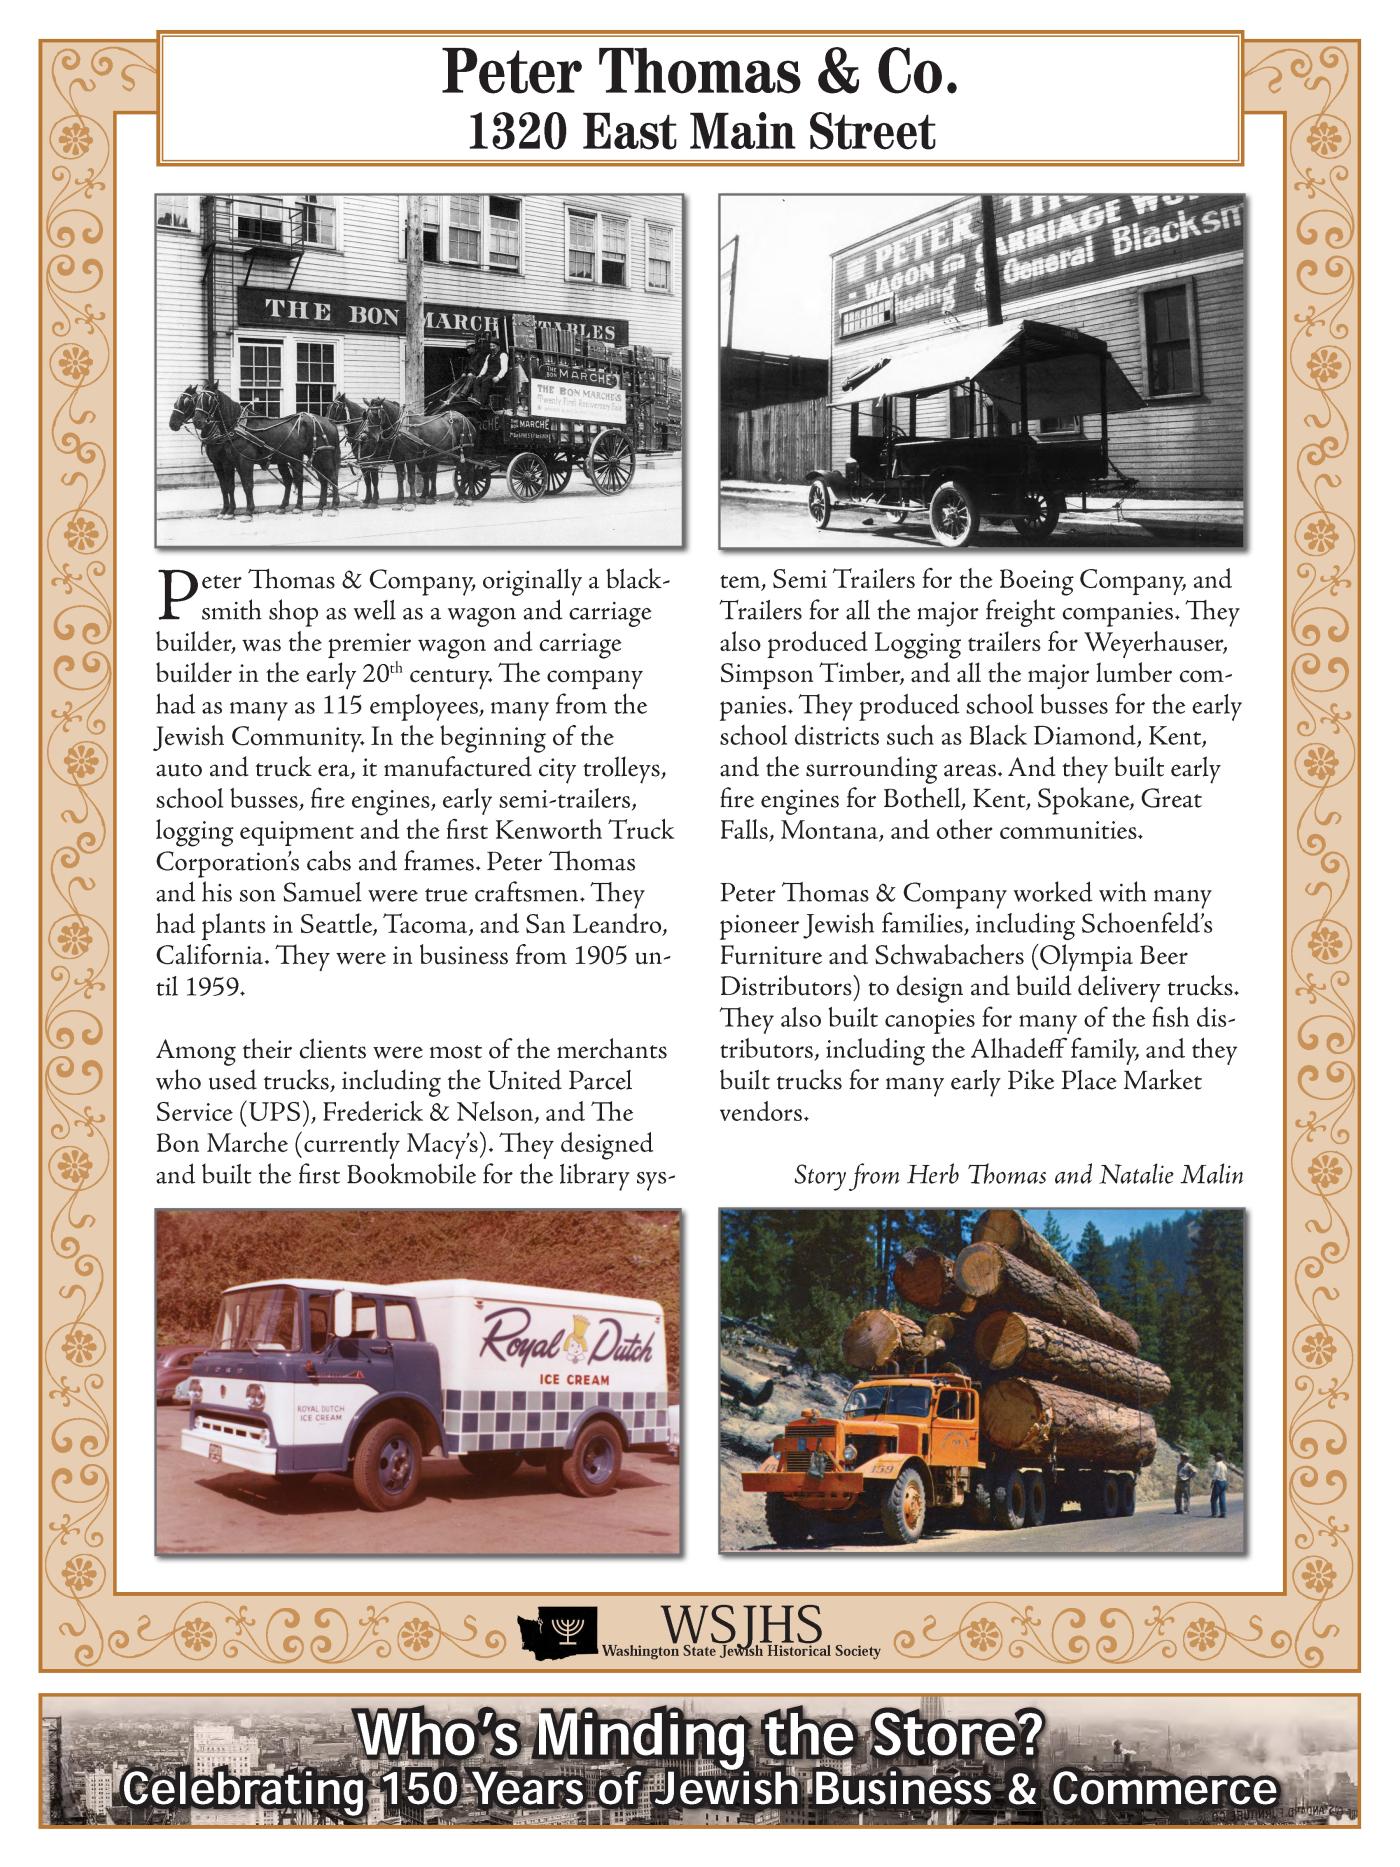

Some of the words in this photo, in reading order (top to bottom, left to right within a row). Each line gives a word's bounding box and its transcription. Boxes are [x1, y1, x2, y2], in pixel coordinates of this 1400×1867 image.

[443, 48, 582, 93] Peter
[599, 48, 800, 93] Thomas
[818, 47, 859, 93] &
[878, 47, 957, 93] Co.
[470, 112, 566, 149] 1320
[583, 113, 676, 149] East
[690, 112, 795, 149] Main
[810, 112, 935, 149] Street
[875, 213, 980, 273] PETER
[1003, 195, 1090, 223] TH
[865, 260, 935, 299] WAGON
[895, 277, 957, 315] hoeing
[1003, 235, 1094, 285] General
[265, 298, 331, 321] THE
[349, 305, 400, 326] BON
[423, 311, 500, 332] MARCH
[537, 384, 555, 394] THE
[559, 386, 580, 397] BON
[248, 569, 334, 589] Thomas
[343, 571, 361, 589] &
[370, 569, 475, 596] Company,
[483, 569, 582, 596] originally
[589, 577, 599, 588] a
[607, 568, 669, 589] black-
[721, 631, 760, 651] also
[768, 631, 867, 658] produced
[875, 632, 961, 659] Logging
[969, 632, 1040, 651] trailers
[1048, 631, 1077, 651] for
[1085, 631, 1227, 658] Weyerhauser,
[157, 663, 232, 682] builder
[239, 664, 258, 682] in
[267, 662, 299, 682] the
[307, 663, 356, 689] early
[410, 669, 492, 689] century.
[499, 663, 540, 682] The
[548, 670, 643, 689] company
[157, 788, 223, 808] school
[231, 788, 303, 810] busses,
[311, 788, 344, 808] fire
[352, 790, 435, 815] engines,
[443, 788, 492, 815] early
[500, 788, 636, 810] semi-trailers,
[156, 819, 233, 846] logging
[240, 821, 354, 846] equipment
[361, 819, 399, 839] and
[407, 819, 439, 839] the
[447, 819, 488, 839] first
[496, 819, 601, 839] Kenworth
[609, 819, 674, 839] Truck
[721, 819, 773, 841] Falls,
[782, 820, 883, 841] Montana,
[891, 819, 929, 839] and
[937, 819, 992, 839] other
[1000, 821, 1142, 839] communities.
[307, 851, 351, 871] cabs
[359, 851, 397, 870] and
[404, 850, 480, 871] frames.
[488, 852, 542, 871] Peter
[549, 851, 635, 871] Thomas
[720, 915, 799, 940] pioneer
[804, 913, 874, 938] Jewish
[882, 912, 968, 935] families,
[976, 913, 1075, 940] including
[721, 945, 822, 964] Furniture
[830, 944, 868, 964] and
[876, 944, 1024, 964] Schwabachers
[1032, 944, 1132, 971] (Olympia
[1141, 945, 1188, 964] Beer
[157, 976, 178, 996] til
[188, 977, 245, 996] 1959.
[721, 975, 860, 1001] Distributors)
[869, 982, 889, 995] to
[897, 976, 963, 1003] design
[971, 976, 1009, 995] and
[1017, 975, 1071, 995] build
[1078, 975, 1160, 1002] delivery
[1168, 975, 1238, 995] trucks.
[157, 1102, 232, 1121] Service
[240, 1101, 315, 1127] (UPS),
[324, 1101, 423, 1121] Frederick
[430, 1103, 449, 1121] &
[457, 1101, 539, 1123] Nelson,
[546, 1101, 585, 1121] and
[591, 1101, 633, 1121] The
[720, 1101, 808, 1121] vendors.
[157, 1133, 199, 1152] Bon
[207, 1132, 288, 1152] Marche
[296, 1132, 400, 1159] (currently
[499, 1133, 553, 1159] They
[561, 1132, 653, 1160] designed
[794, 1163, 847, 1191] Story
[848, 1162, 901, 1192] from
[908, 1164, 959, 1184] Herb
[968, 1164, 1046, 1184] Thomas
[1055, 1163, 1092, 1184] and
[1101, 1164, 1173, 1184] Natalie
[1181, 1164, 1243, 1184] Malin
[480, 1307, 566, 1368] Royal
[587, 1318, 656, 1366] Dutch
[540, 1374, 560, 1385] ICE
[566, 1374, 610, 1386] CREAM
[297, 1404, 319, 1413] ROYAL
[321, 1404, 345, 1413] DUTCH
[300, 1414, 313, 1422] ICE
[315, 1414, 343, 1422] CREAM
[870, 1465, 895, 1475] 159
[660, 1604, 823, 1649] WSJHS
[602, 1644, 680, 1660] Washington
[684, 1644, 717, 1657] State
[720, 1644, 764, 1658] Jewish
[768, 1644, 832, 1657] Historical
[836, 1644, 881, 1660] Society
[539, 1712, 745, 1770] Minding
[765, 1712, 854, 1756] the
[875, 1712, 1044, 1756] Store?
[124, 1771, 364, 1816] Celebrating
[382, 1771, 459, 1805] 150
[472, 1771, 584, 1805] Years
[599, 1771, 642, 1805] of
[655, 1771, 799, 1805] Jewish
[816, 1771, 992, 1805] Business
[1008, 1772, 1037, 1805] &
[1053, 1771, 1278, 1805] Commerce
